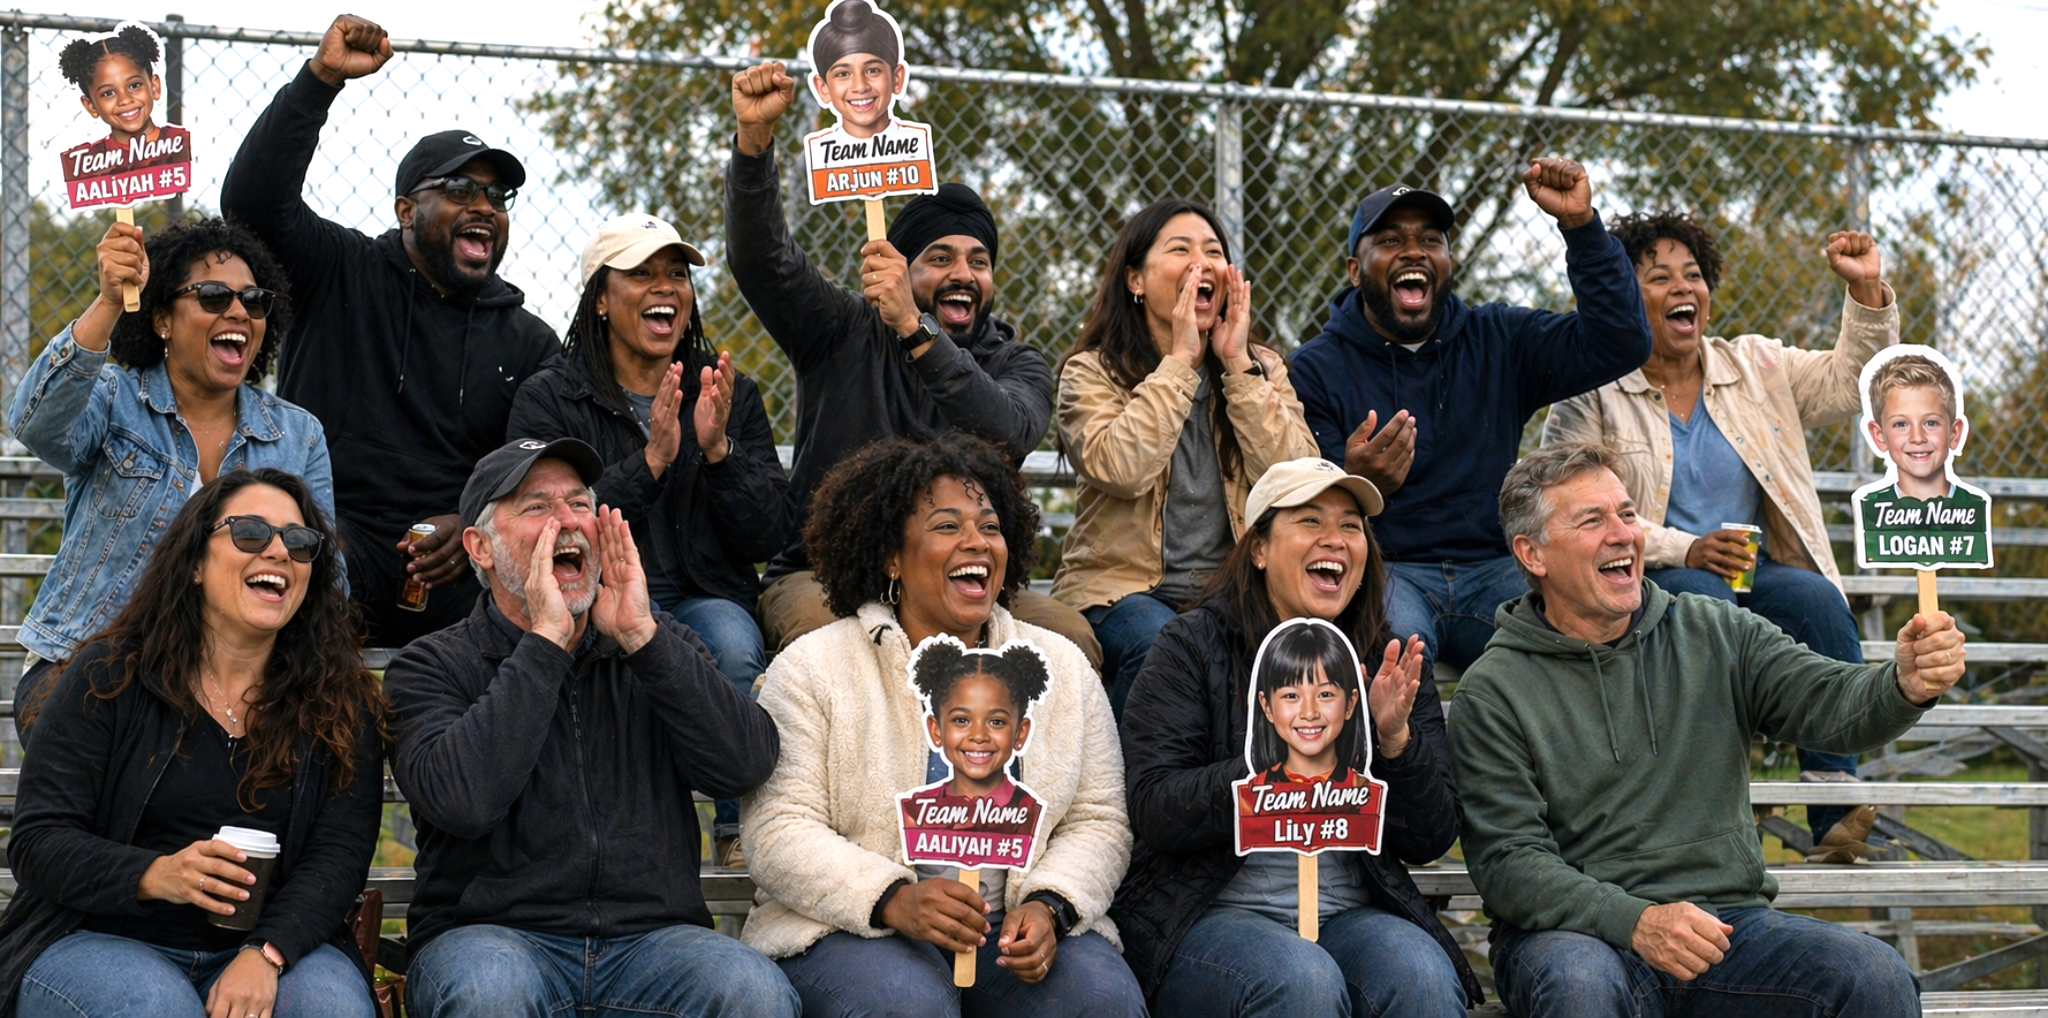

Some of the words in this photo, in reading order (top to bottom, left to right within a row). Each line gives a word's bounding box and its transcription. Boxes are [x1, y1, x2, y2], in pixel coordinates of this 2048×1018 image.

[69, 148, 124, 177] Team
[128, 134, 183, 163] Name
[819, 140, 868, 164] Team
[158, 166, 186, 188] #5
[886, 165, 919, 185] #10
[1873, 501, 1922, 528] Team
[1925, 500, 1976, 525] Name
[1878, 534, 1944, 556] LOGAN
[1949, 535, 1975, 556] #7
[1251, 784, 1307, 813] Team
[1311, 780, 1370, 809] Name
[915, 797, 968, 826] Team
[971, 797, 1028, 825] Name
[1320, 818, 1348, 840] #8
[996, 838, 1023, 859] #5
